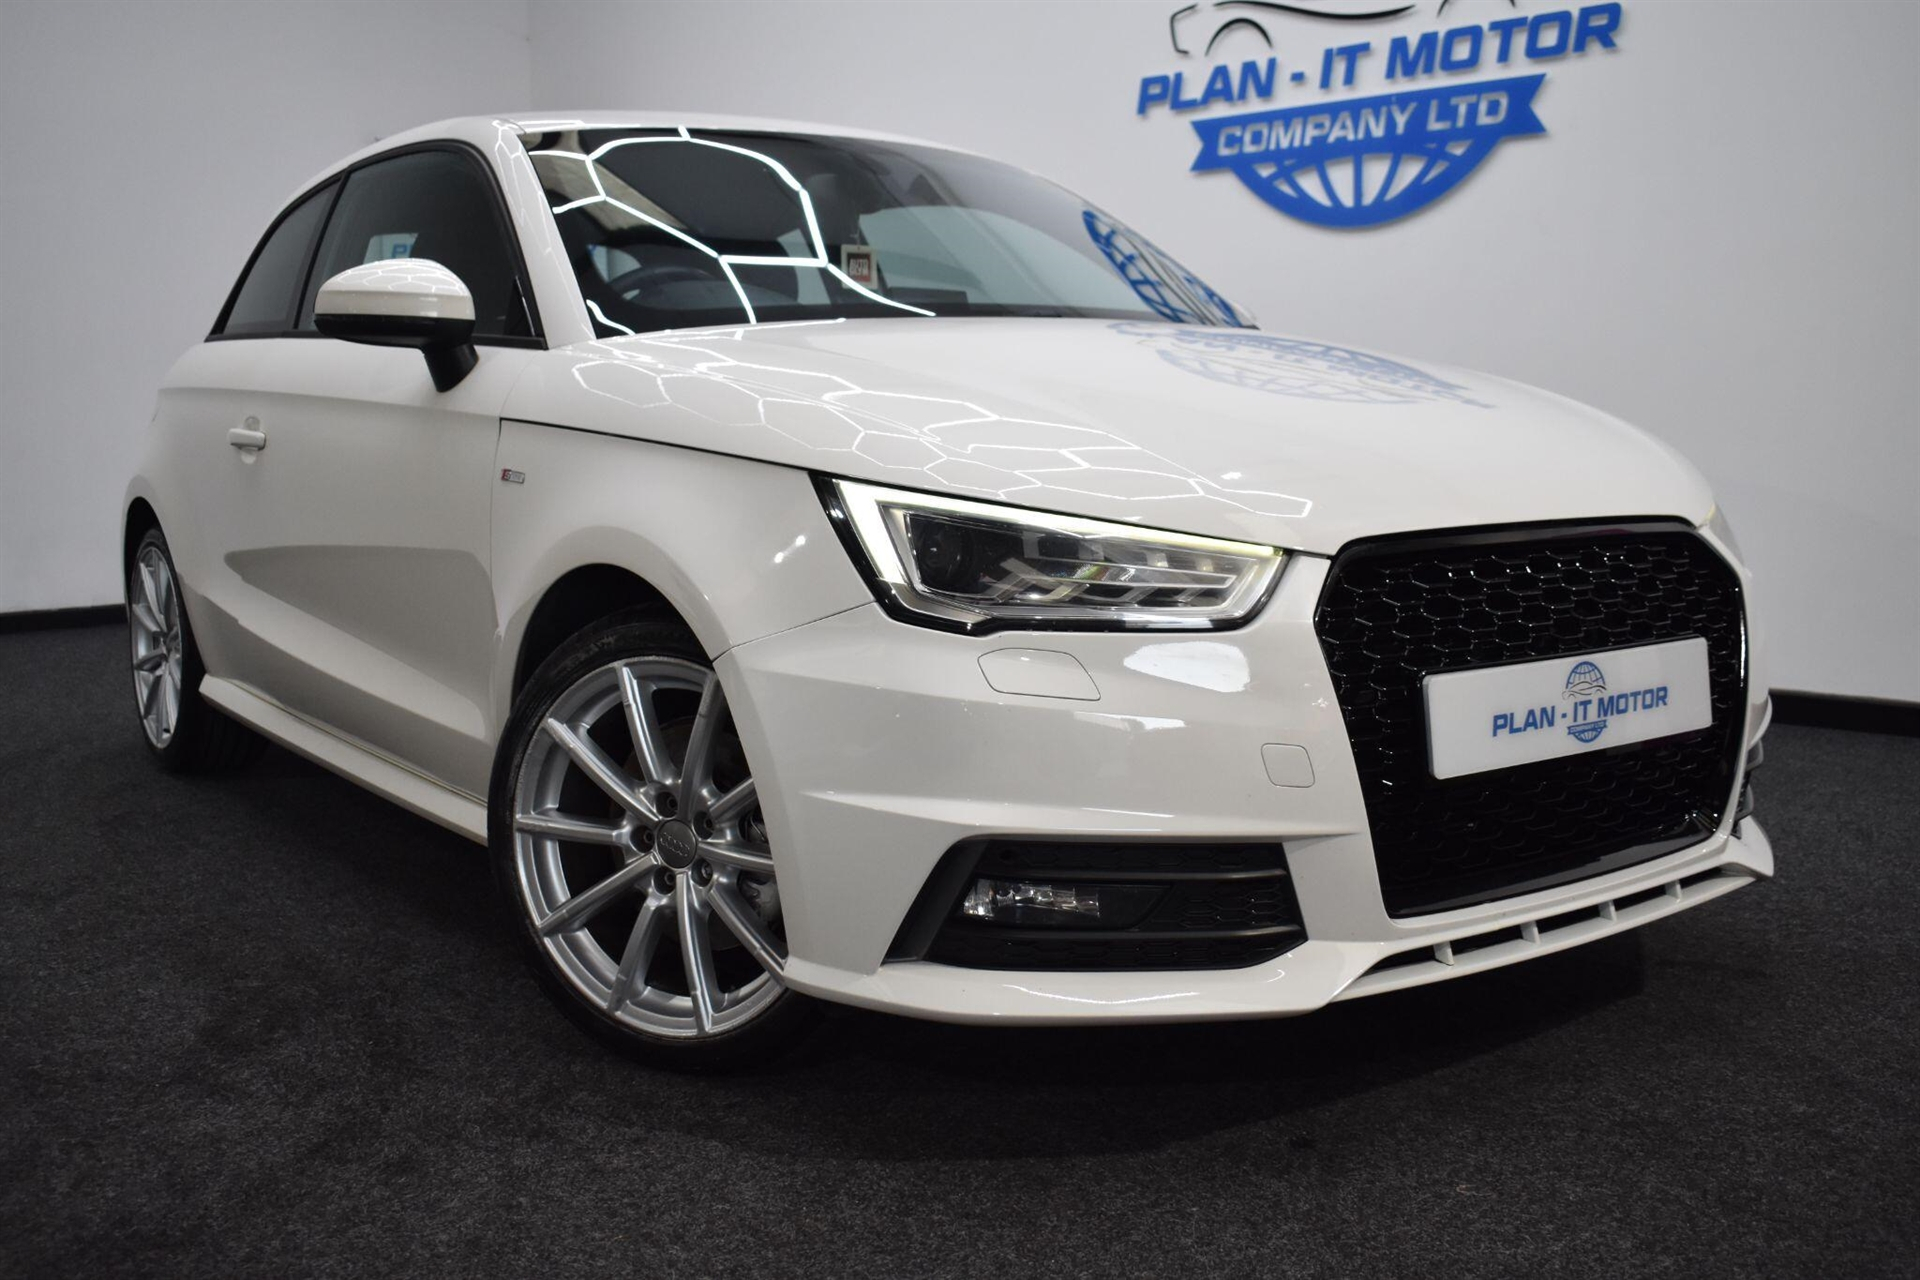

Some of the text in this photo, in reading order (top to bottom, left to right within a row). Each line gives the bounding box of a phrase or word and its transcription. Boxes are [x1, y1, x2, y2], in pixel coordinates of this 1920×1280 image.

[1137, 57, 1276, 115] PLAN
[1319, 41, 1371, 89] IT
[1385, 2, 1621, 79] MOTOR
[1217, 91, 1509, 156] COMPANY LTD
[1493, 705, 1555, 737] PLAN
[1573, 700, 1592, 723] IT
[1597, 686, 1668, 719] MOTOR
